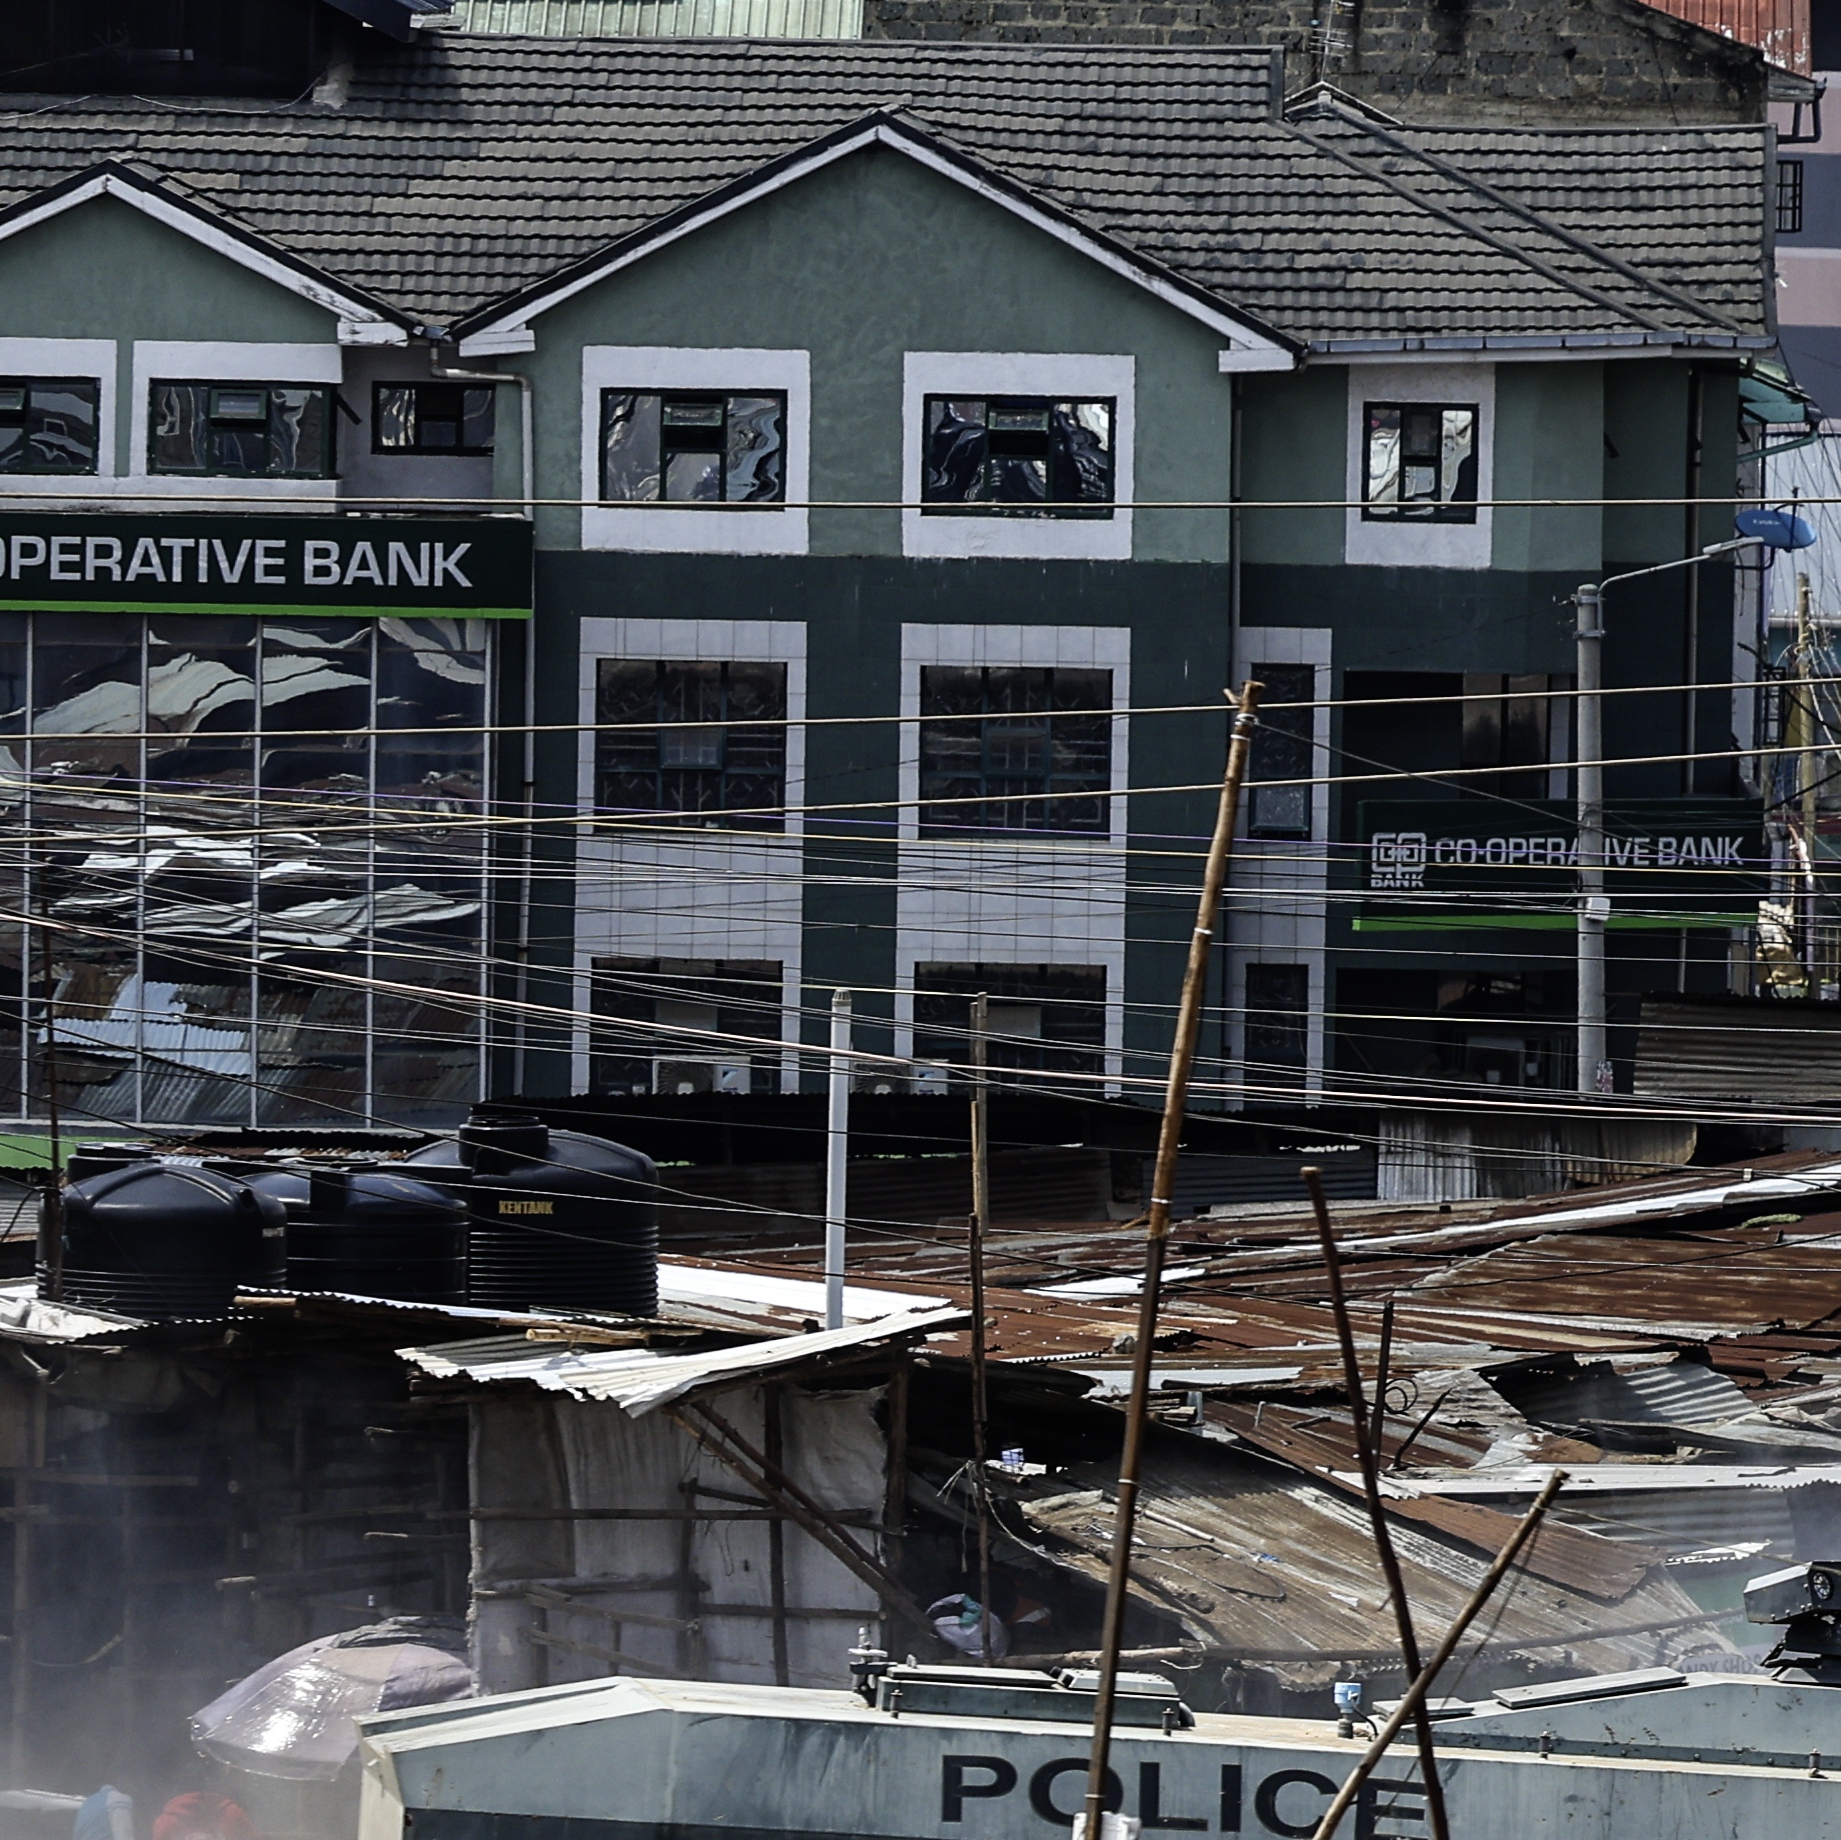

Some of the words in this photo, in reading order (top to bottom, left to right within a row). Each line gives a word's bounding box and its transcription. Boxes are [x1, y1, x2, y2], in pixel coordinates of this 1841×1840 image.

[303, 539, 473, 588] BANK
[1433, 836, 1656, 867] CO-OPERAIVE
[1657, 835, 1745, 867] BANK
[1370, 873, 1425, 889] BANK
[498, 1200, 554, 1215] KENTANK
